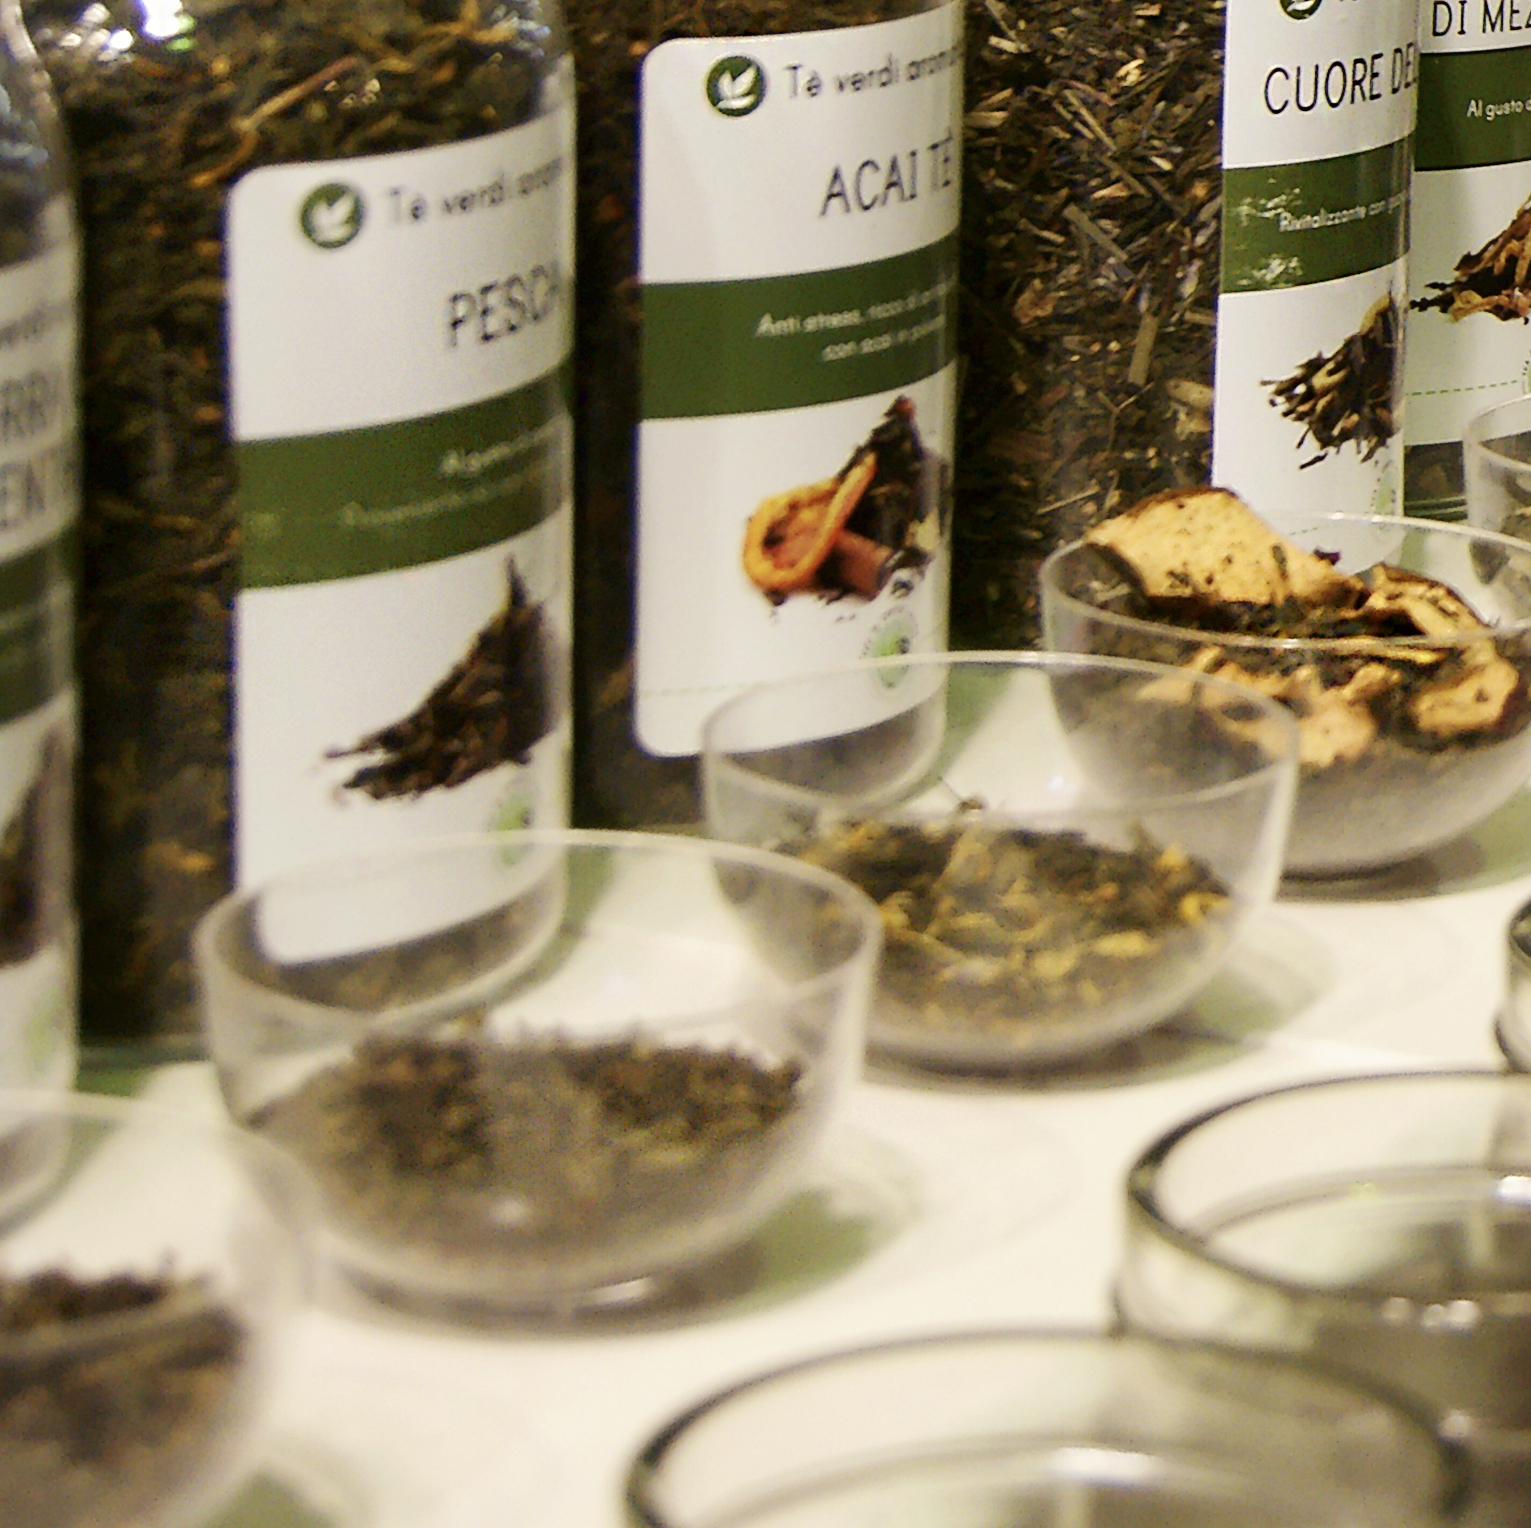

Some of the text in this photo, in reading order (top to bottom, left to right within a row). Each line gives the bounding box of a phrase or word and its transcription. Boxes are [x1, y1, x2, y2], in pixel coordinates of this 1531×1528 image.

[1432, 0, 1468, 37] DI
[784, 64, 822, 99] Tè
[1264, 53, 1384, 115] CUORE
[1466, 99, 1482, 118] Al
[1485, 100, 1524, 121] gusto
[819, 149, 918, 217] ACAI
